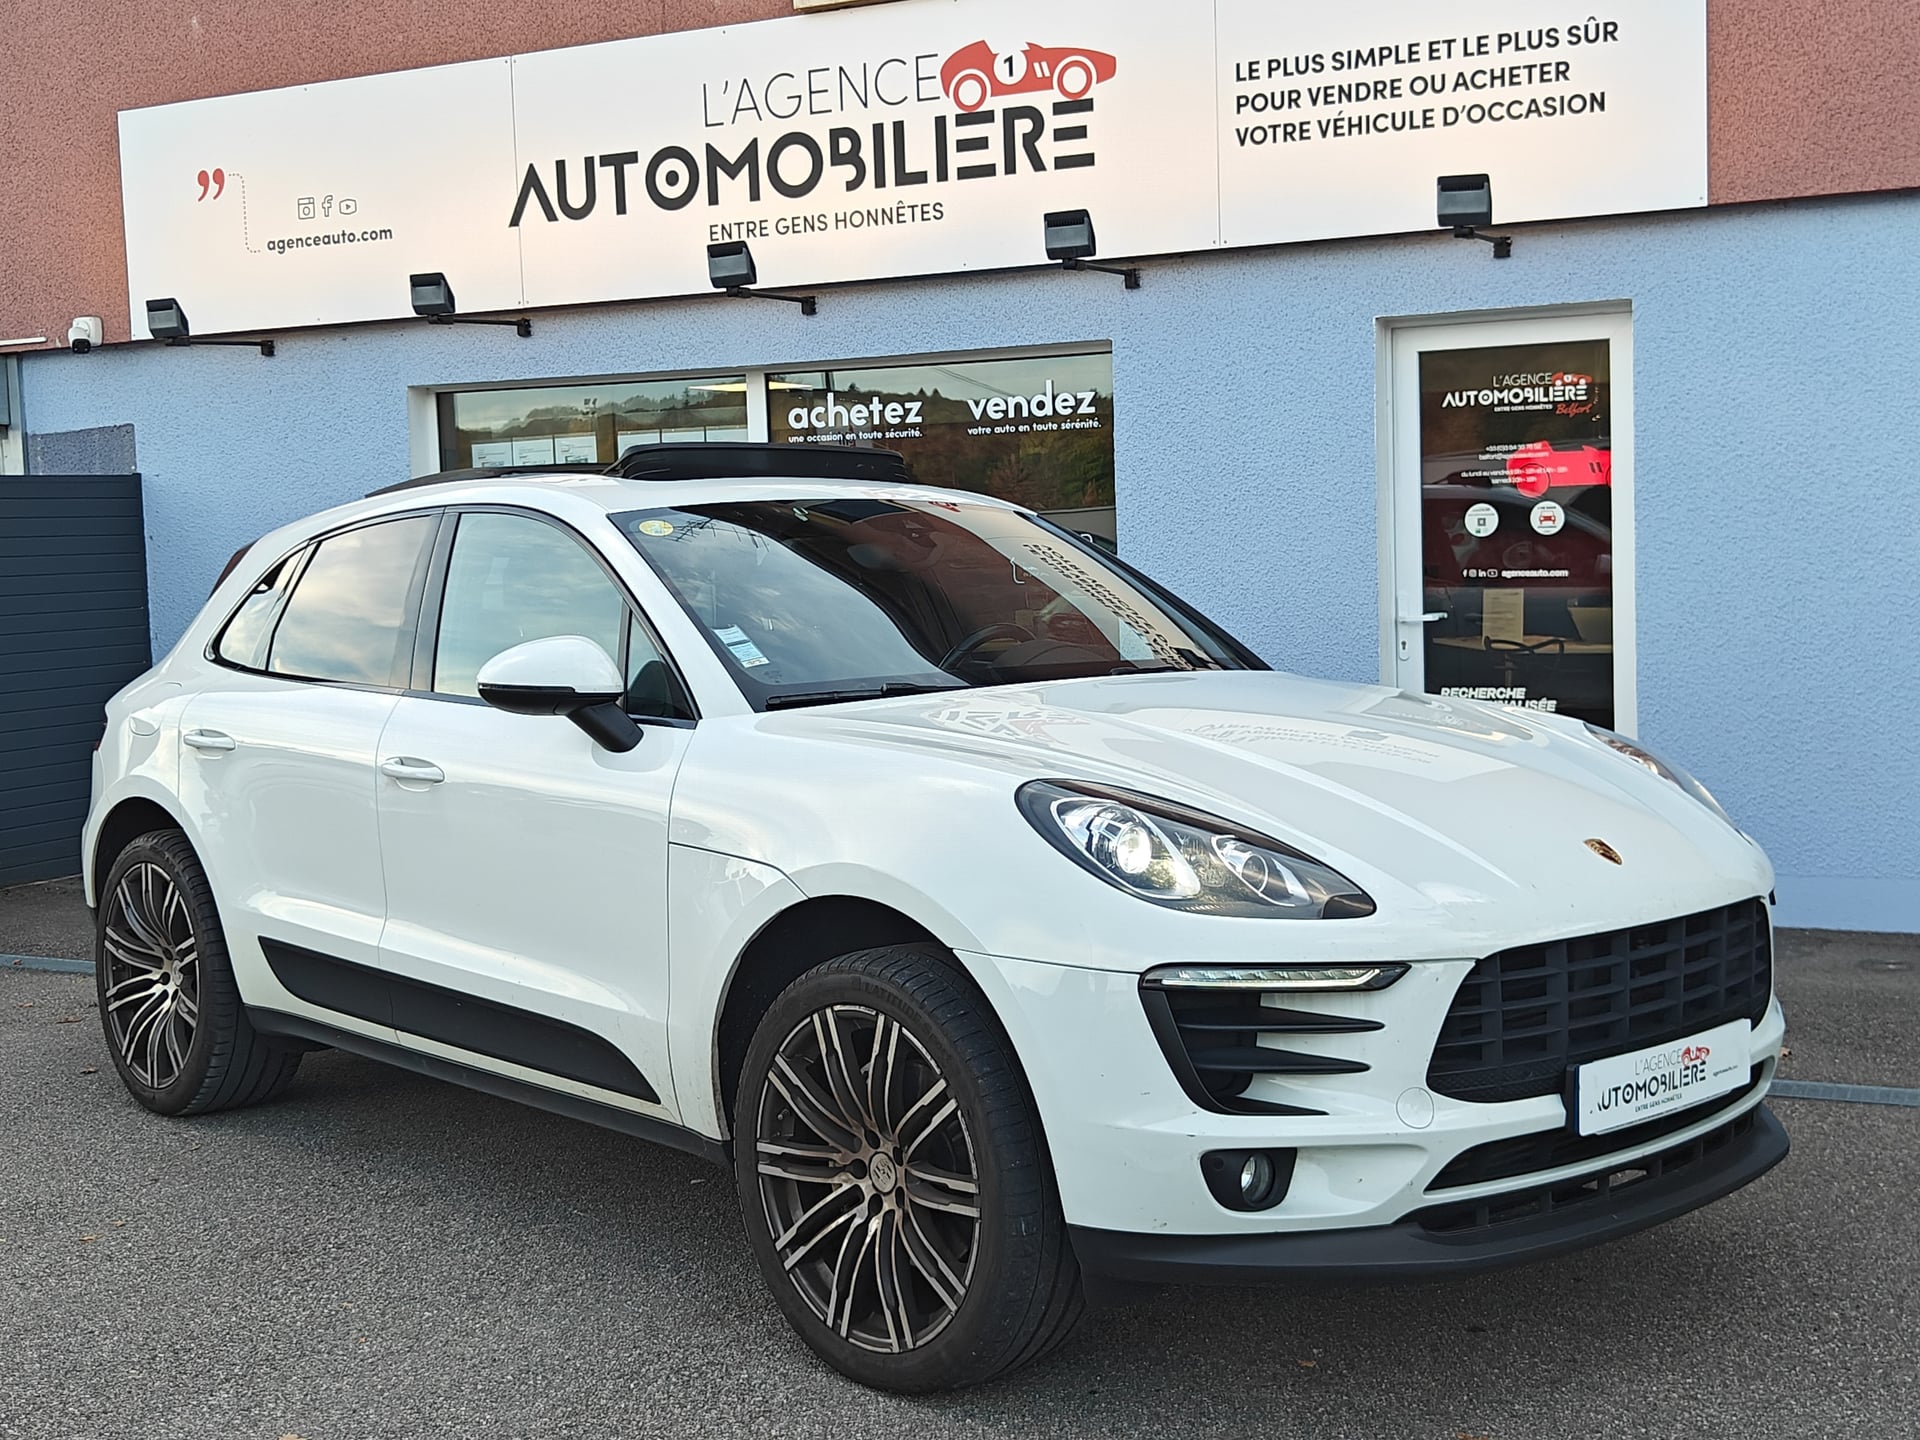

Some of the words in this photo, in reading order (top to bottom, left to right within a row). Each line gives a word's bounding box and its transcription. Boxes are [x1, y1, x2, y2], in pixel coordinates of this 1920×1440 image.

[1235, 61, 1261, 82] LE
[1267, 54, 1325, 78] PLUS
[1331, 43, 1421, 72] SIMPLE
[1428, 38, 1457, 62] ET
[1462, 35, 1490, 57] LE
[1497, 28, 1560, 53] PLUS
[1567, 16, 1619, 46] SÛR
[1003, 55, 1014, 77] 1
[703, 53, 940, 128] L'AGENCE
[1235, 90, 1301, 115] POUR
[1307, 78, 1403, 107] VENDRE
[1409, 74, 1447, 97] OU
[1452, 61, 1570, 92] ACHETER
[1235, 121, 1311, 147] VOTRE
[1317, 110, 1435, 139] VÉHICULE
[1442, 91, 1606, 128] D'OCCASION
[709, 219, 770, 242] ENTRE
[775, 213, 828, 235] GENS
[835, 200, 944, 230] HONNÊTES
[266, 228, 393, 254] agenceauto.com
[1492, 373, 1552, 388] L'AGENCE
[788, 392, 922, 429] achetez
[967, 379, 1096, 421] vendez
[1555, 402, 1593, 418] Belfort
[788, 435, 805, 443] une
[806, 431, 843, 443] occasion
[859, 430, 883, 440] toute
[885, 427, 923, 439] sécurité.
[967, 426, 992, 436] votre
[994, 424, 1016, 434] auto
[1018, 424, 1030, 432] en
[1032, 421, 1058, 431] toute
[1061, 417, 1102, 430] sérénité.
[1440, 687, 1526, 699] RECHERCHE
[1635, 1048, 1682, 1075] L'AGENCE
